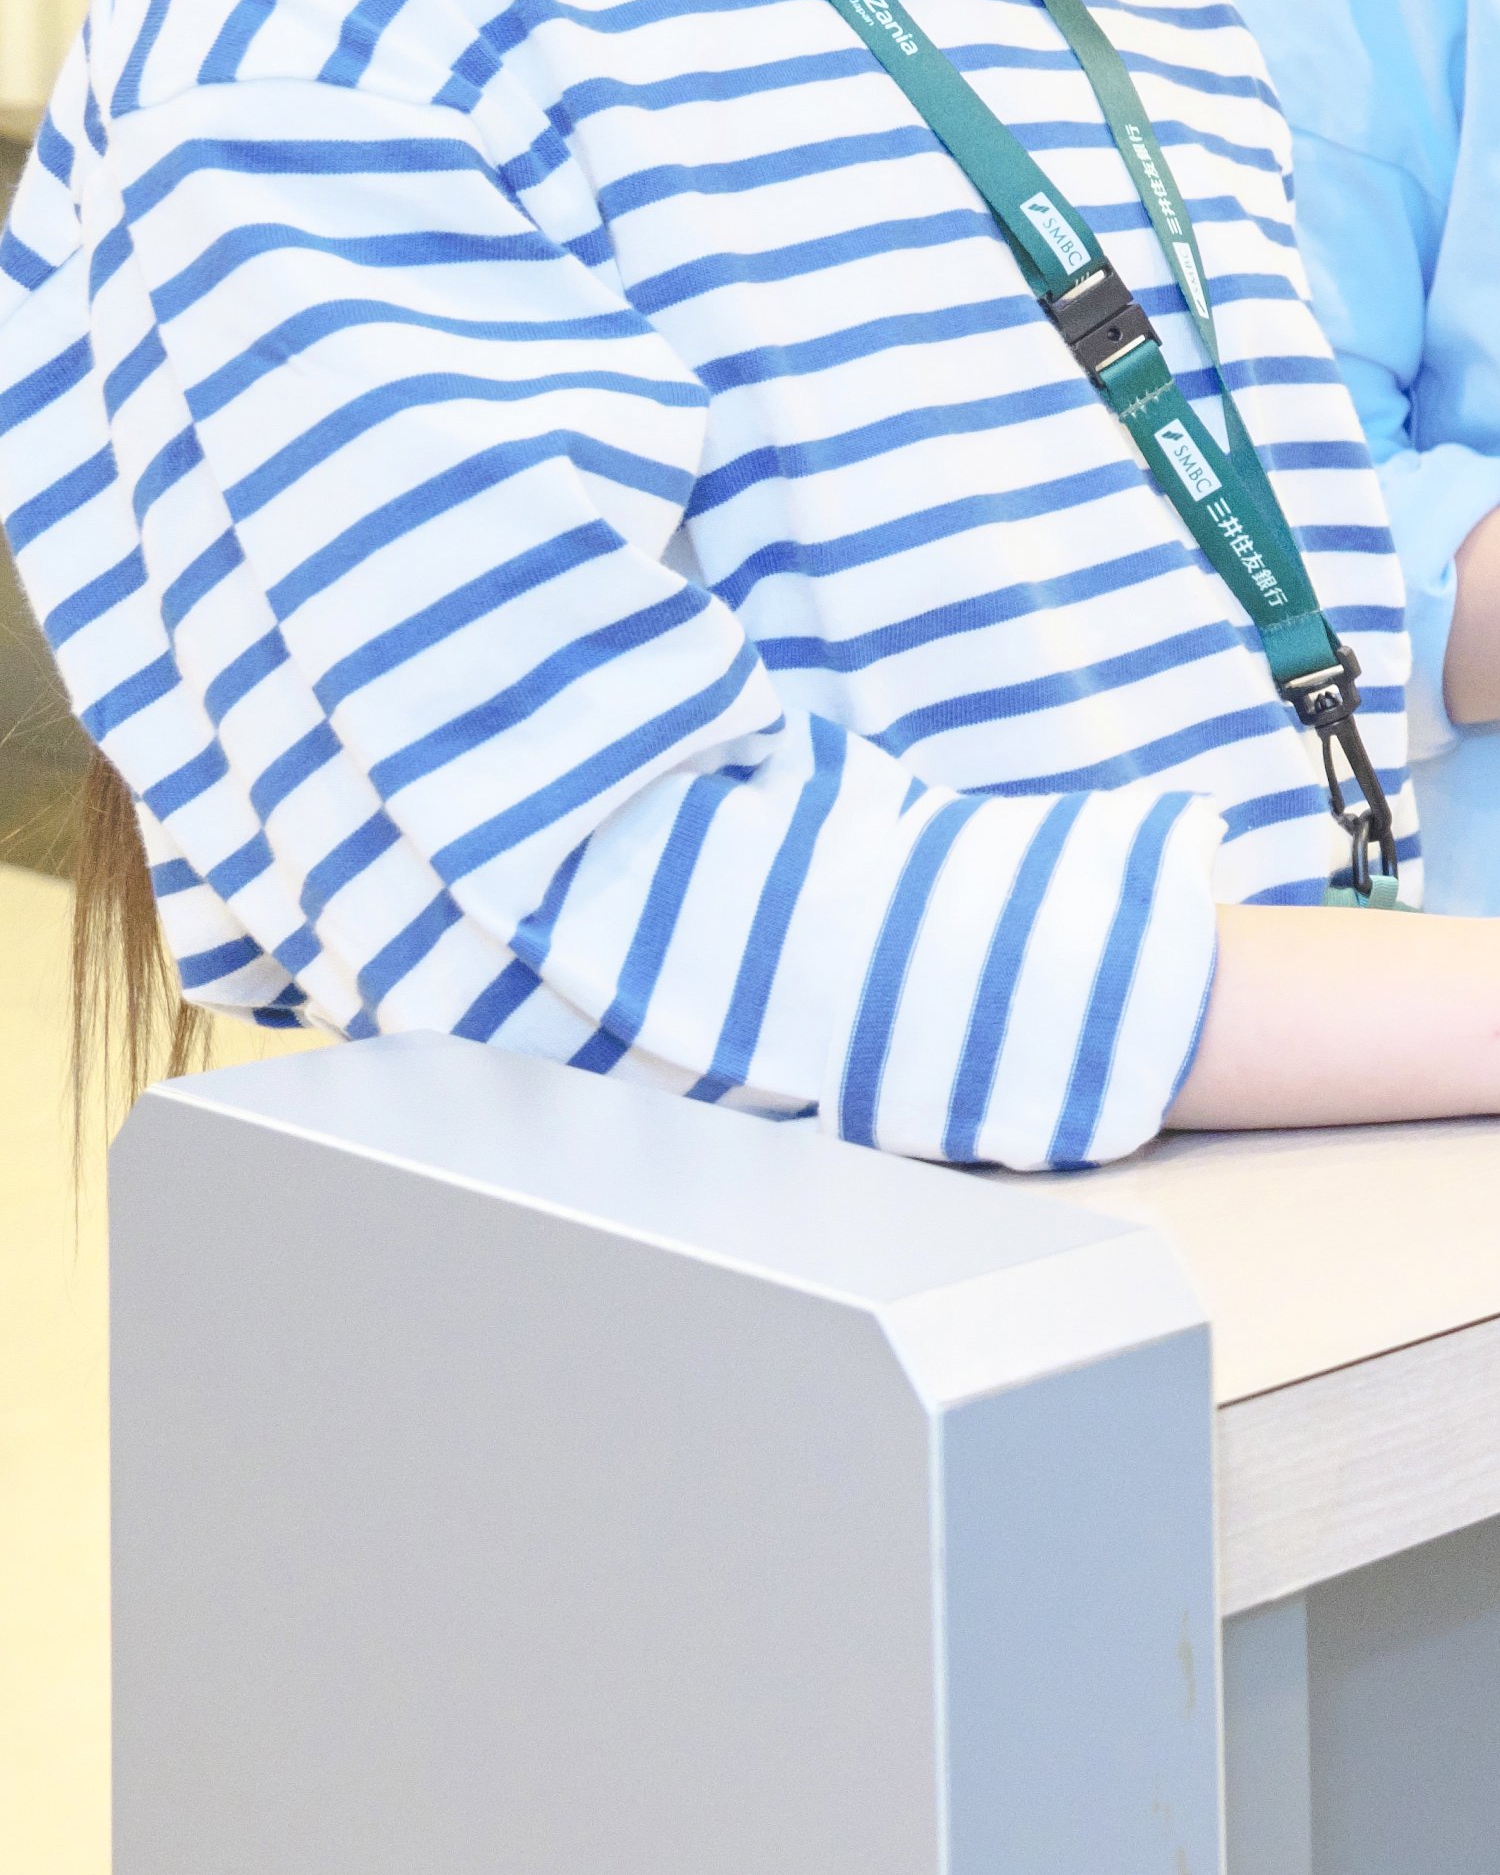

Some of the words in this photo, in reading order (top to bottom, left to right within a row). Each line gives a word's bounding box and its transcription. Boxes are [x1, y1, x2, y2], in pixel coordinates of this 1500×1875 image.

[1043, 217, 1083, 267] SMBC
[1174, 445, 1212, 493] SMBC
[1206, 497, 1289, 607] 三井住友銀行
